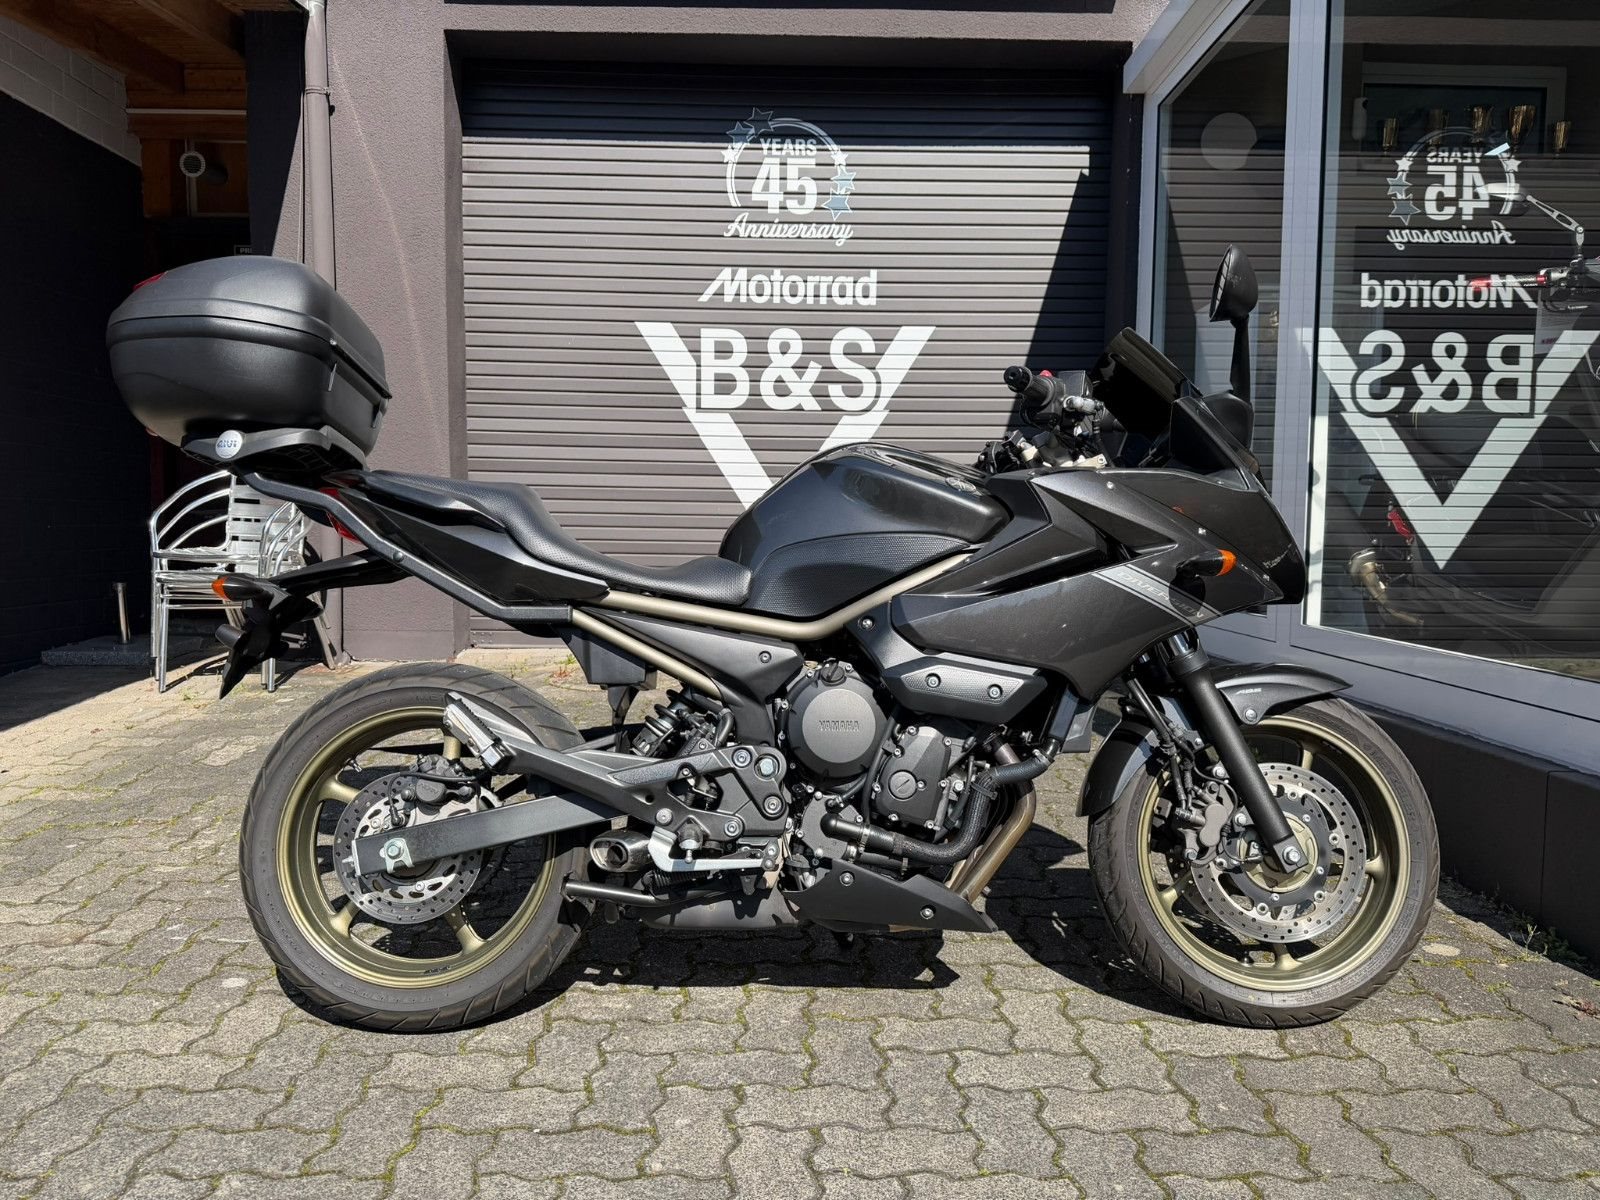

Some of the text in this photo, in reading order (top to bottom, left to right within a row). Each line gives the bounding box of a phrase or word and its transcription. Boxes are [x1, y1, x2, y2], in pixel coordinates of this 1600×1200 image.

[760, 138, 817, 156] YEARS
[751, 157, 818, 215] 45
[723, 212, 854, 246] Anniversary
[698, 267, 878, 306] Motorrad
[699, 327, 877, 411] B&S
[818, 719, 860, 732] YAMAHA
